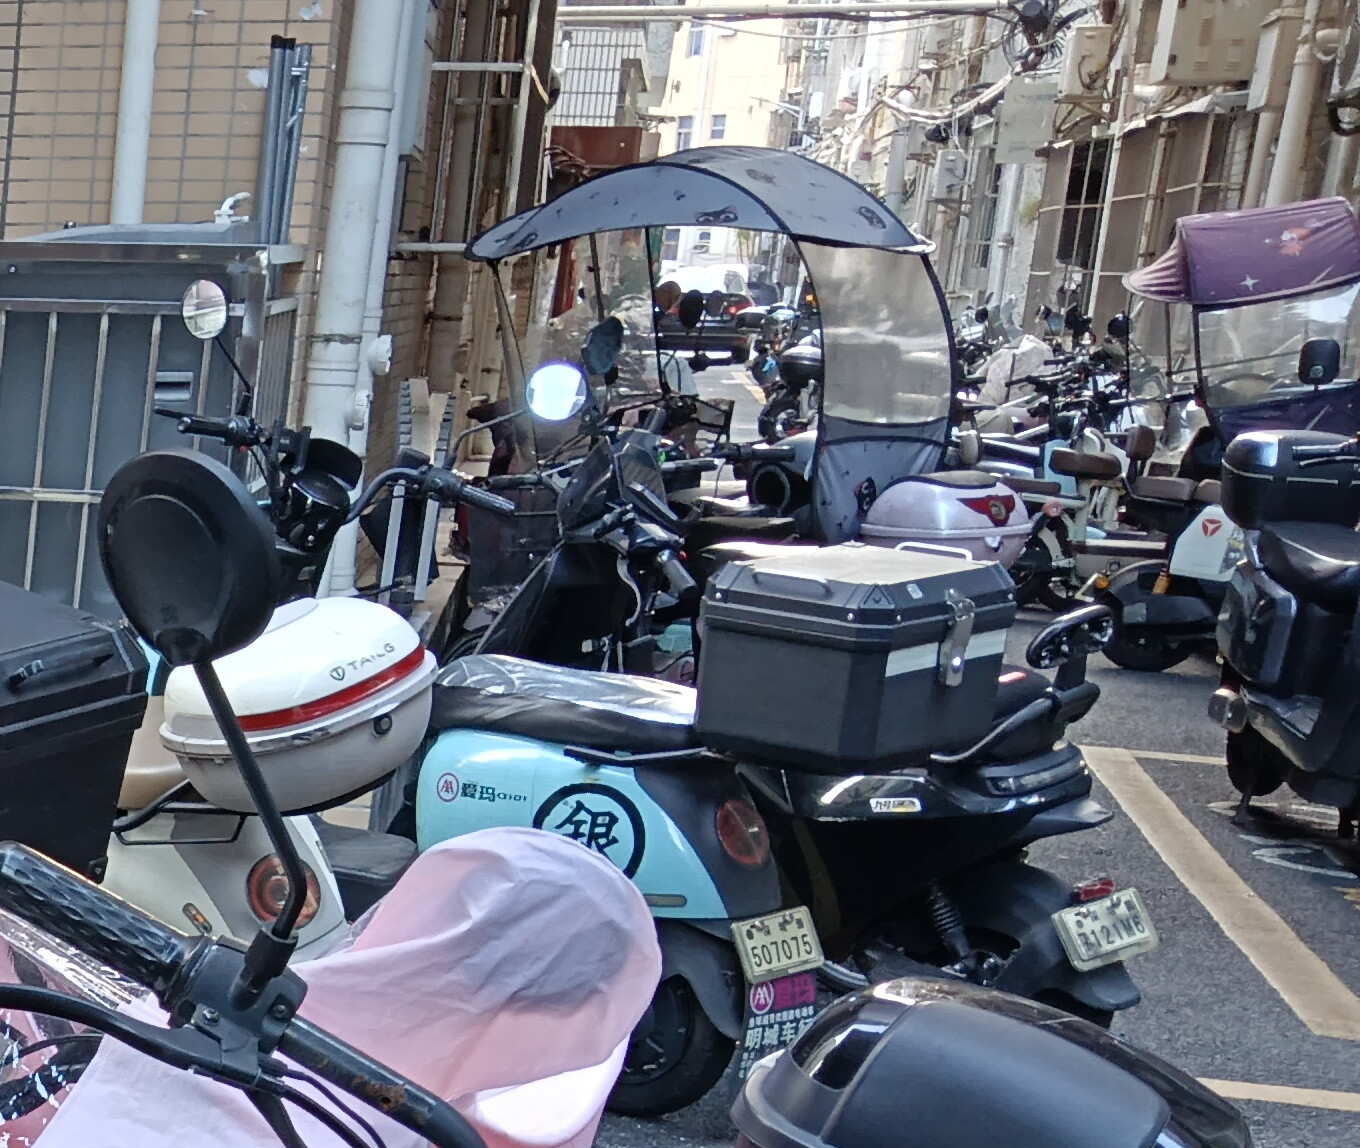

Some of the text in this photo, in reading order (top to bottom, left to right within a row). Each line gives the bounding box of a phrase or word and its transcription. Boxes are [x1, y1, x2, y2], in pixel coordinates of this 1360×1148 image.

[750, 933, 813, 968] 507075
[744, 1017, 812, 1051] 明城车
